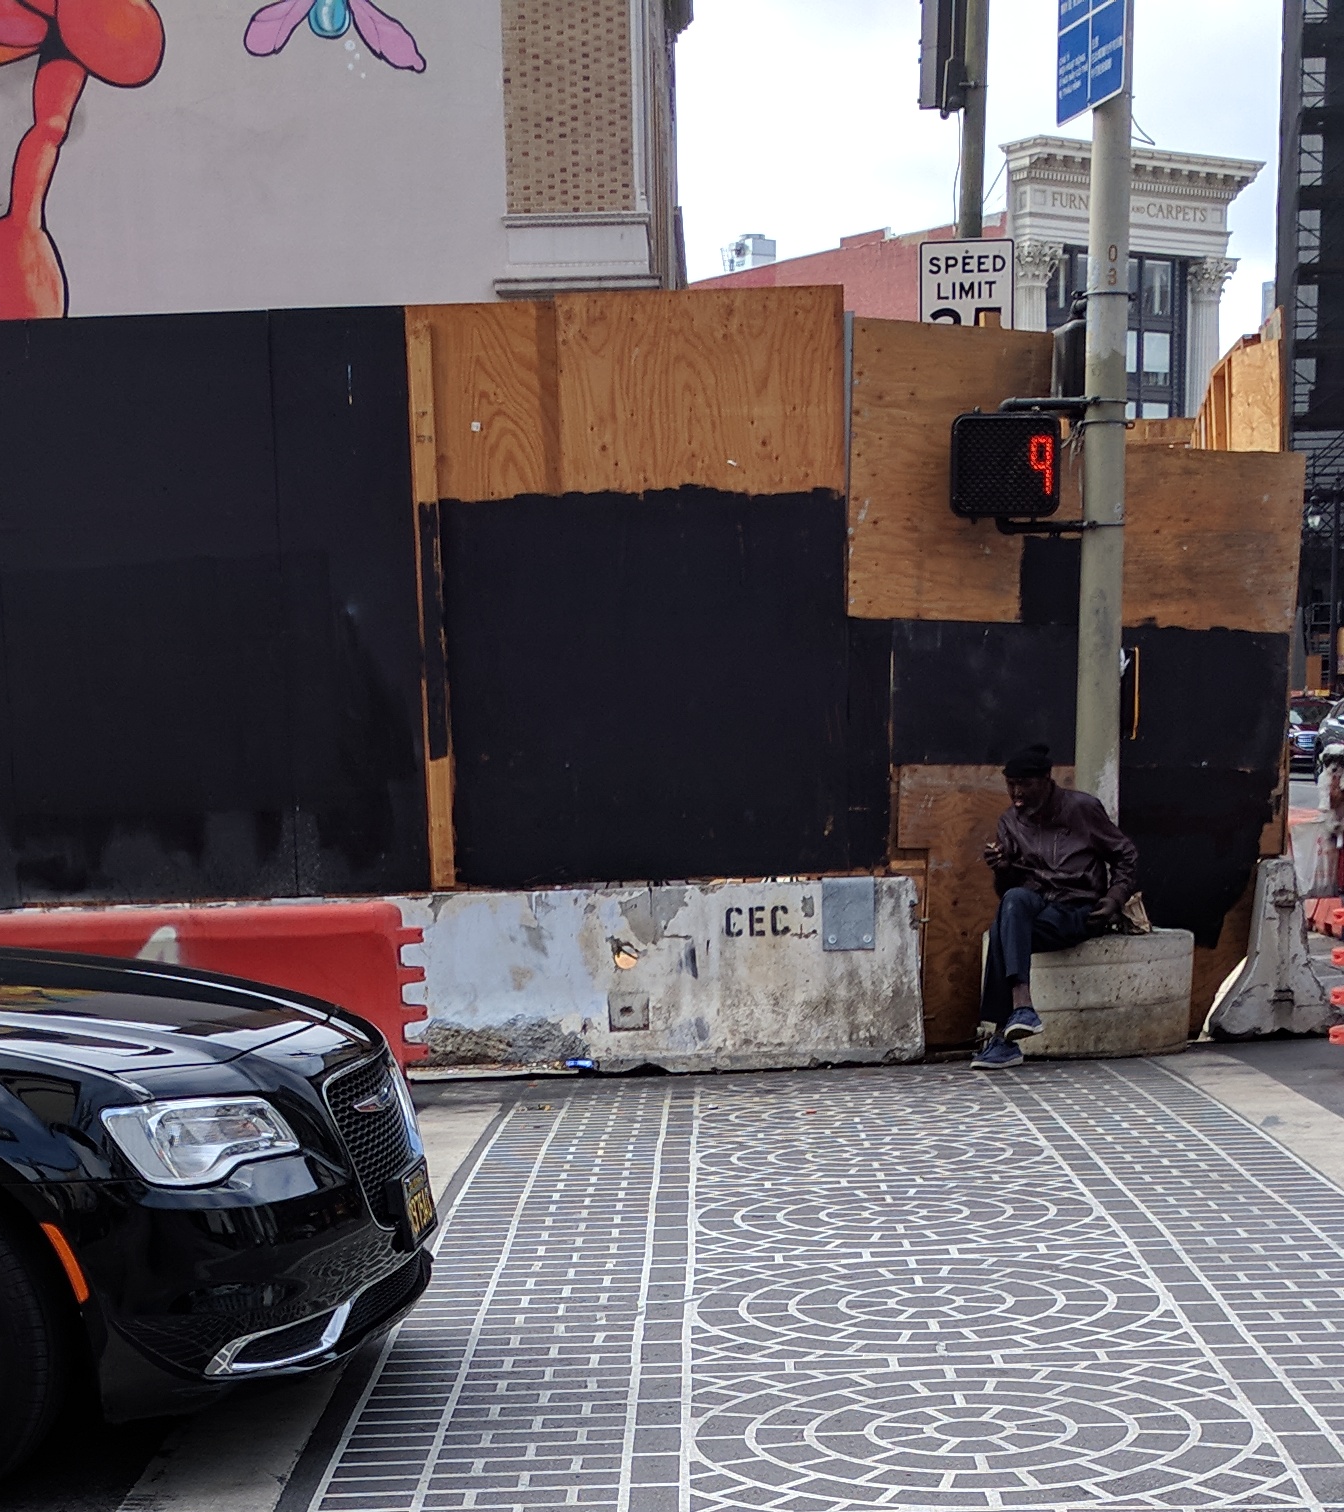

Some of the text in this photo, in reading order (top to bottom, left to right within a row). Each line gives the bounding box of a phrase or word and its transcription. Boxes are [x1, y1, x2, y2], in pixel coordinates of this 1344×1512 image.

[1146, 203, 1207, 223] CARPETS
[929, 254, 1006, 275] SPEED
[937, 280, 997, 300] LIMIT
[1029, 434, 1054, 495] 9
[725, 905, 791, 938] CEC
